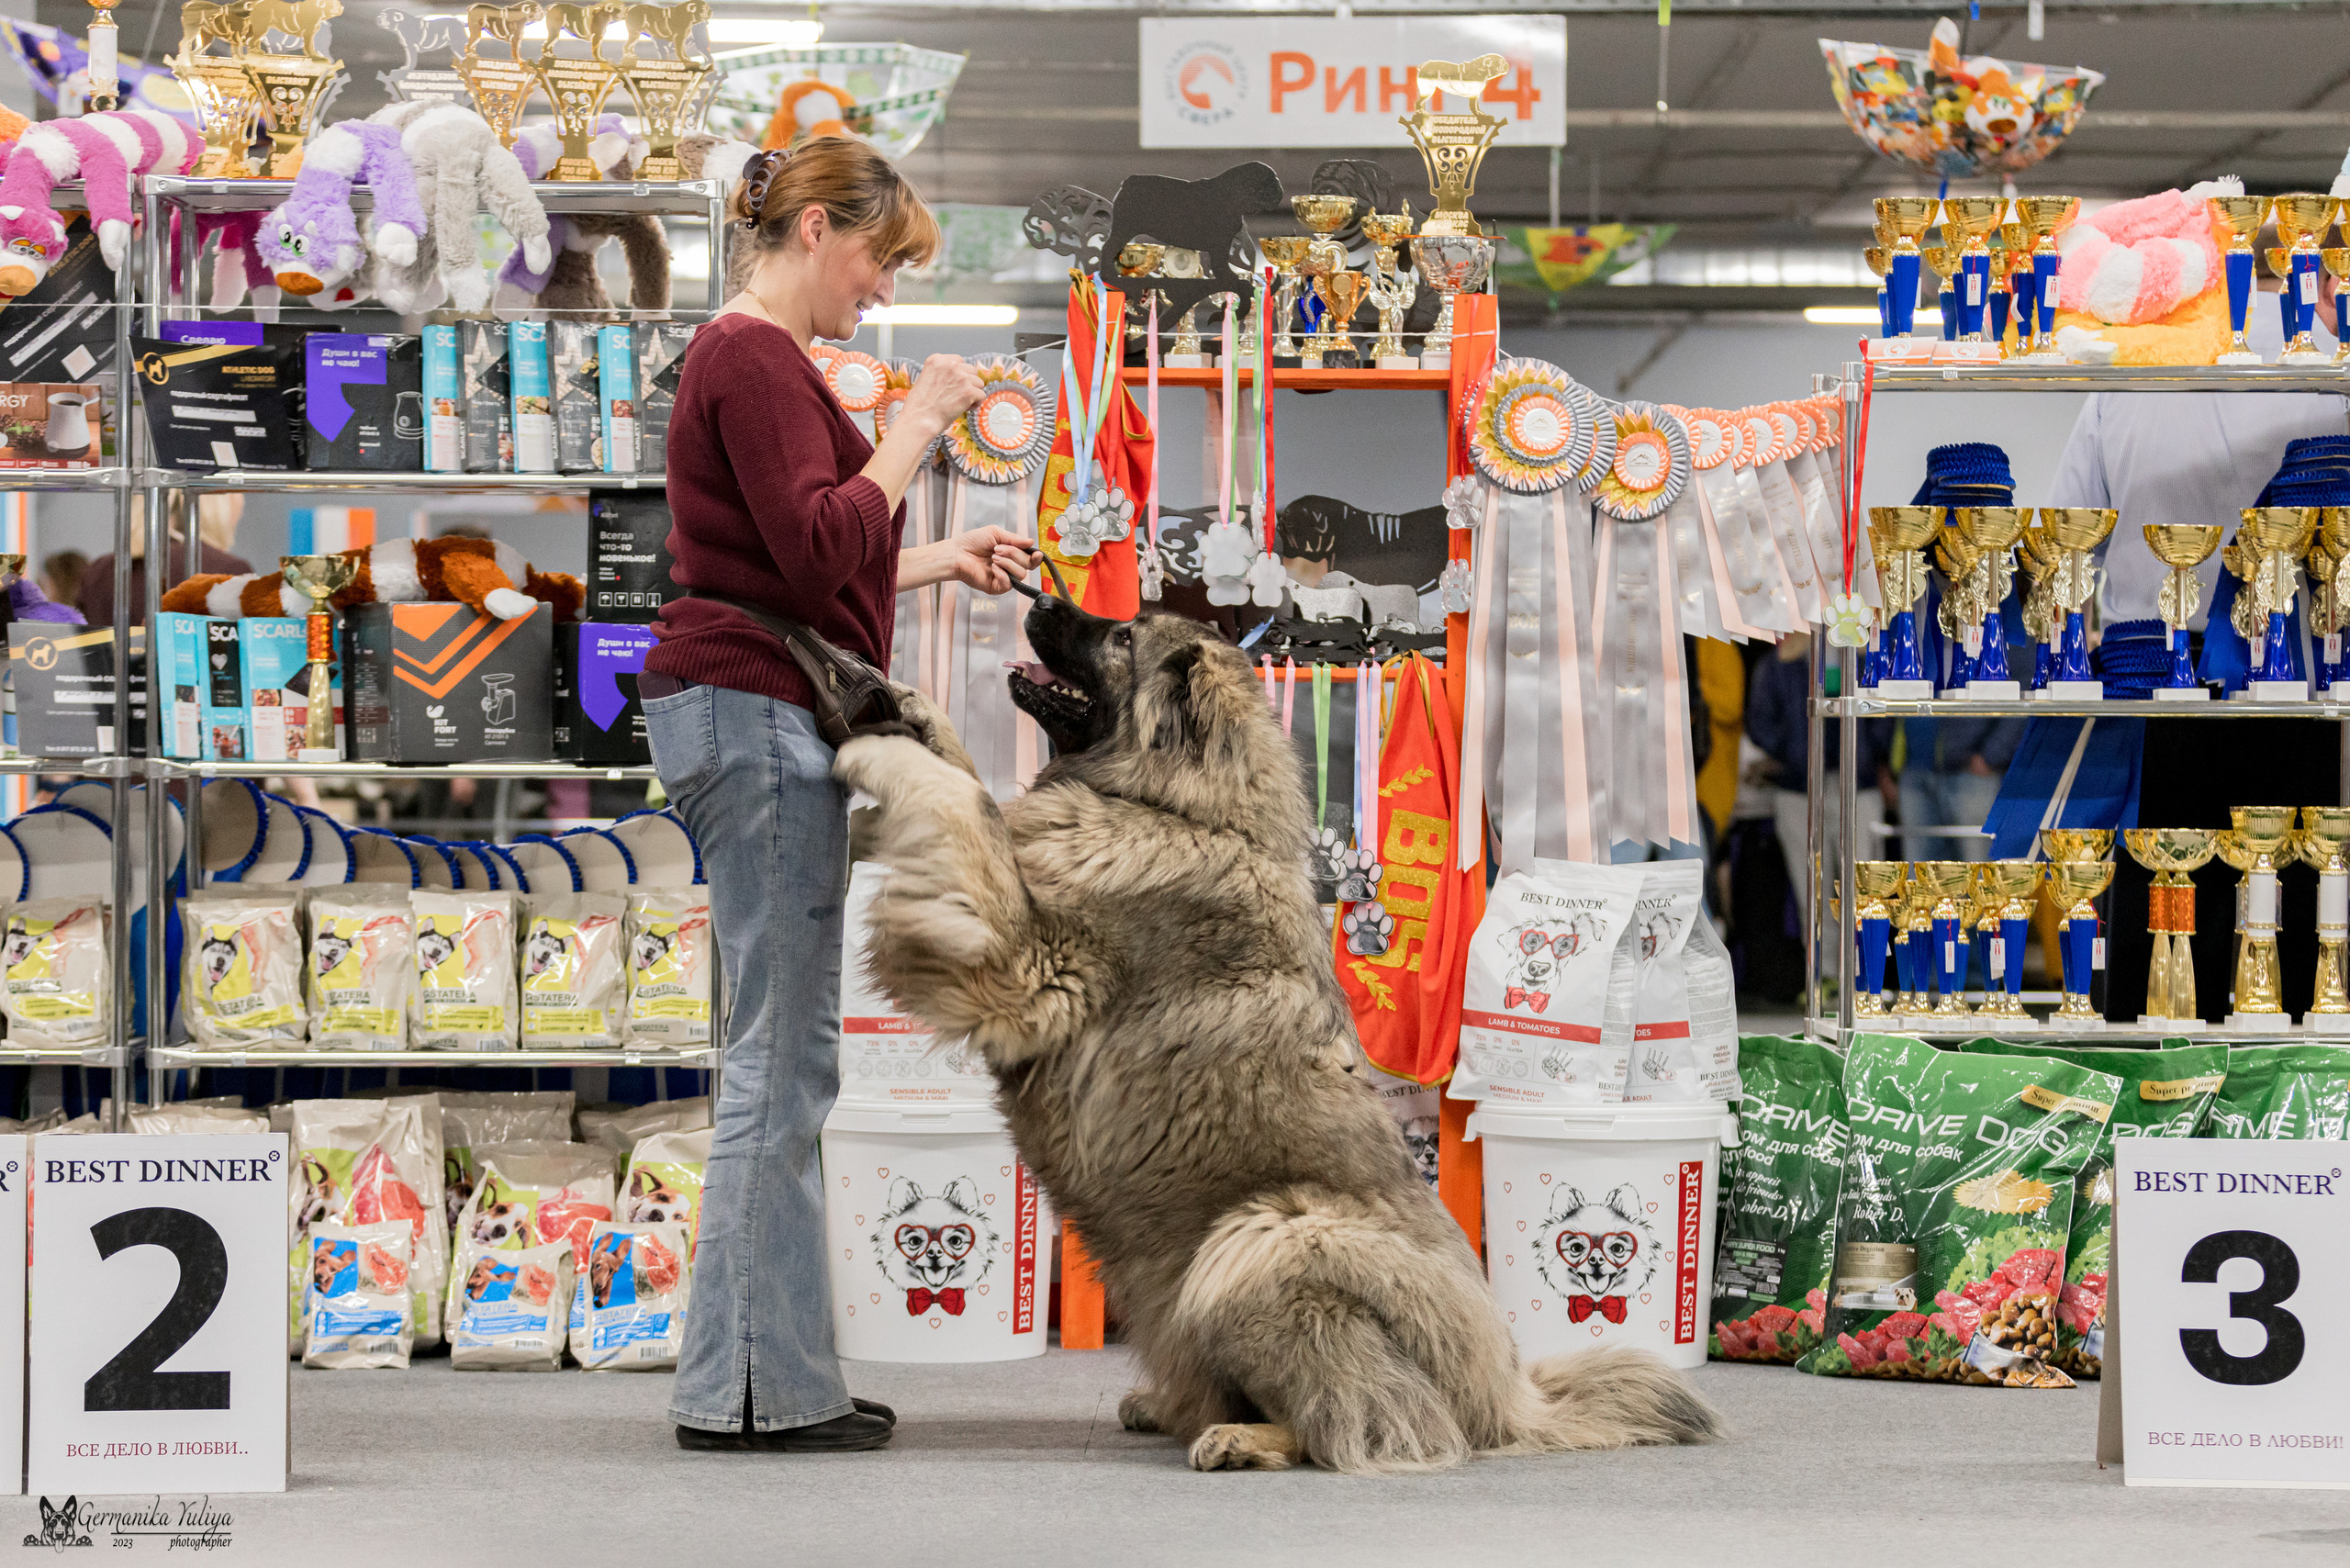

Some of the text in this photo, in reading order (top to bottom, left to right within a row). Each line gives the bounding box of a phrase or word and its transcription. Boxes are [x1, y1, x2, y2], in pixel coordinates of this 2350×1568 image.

[1482, 46, 1541, 121] 4
[1420, 125, 1487, 135] МНОПОРОДНОЙ
[321, 348, 351, 358] Души
[257, 365, 275, 374] DOG
[336, 359, 360, 367] чаю!
[599, 531, 634, 541] Всегда
[599, 543, 632, 552] что-то
[599, 554, 656, 563] новенькое!
[253, 623, 306, 639] SCARL
[597, 638, 624, 648] Души
[611, 649, 633, 657] чаю!
[1365, 808, 1450, 972] BOS
[1520, 891, 1604, 911] BEST DINNER
[878, 1022, 902, 1030] LAMB
[1488, 1017, 1561, 1035] LAMB & TOMATOES
[1700, 1071, 1718, 1081] BEST
[1489, 1084, 1545, 1098] SENSIBLE ADULT
[2031, 1089, 2055, 1106] Super
[2149, 1083, 2177, 1095] Super
[1741, 1093, 1851, 1148] DRIVE
[1847, 1097, 2069, 1157] DRIVE DOG
[1765, 1139, 1800, 1155] для
[1874, 1138, 1912, 1157] для
[1915, 1144, 1964, 1163] собак
[1743, 1146, 1775, 1167] food
[45, 1159, 272, 1183] BEST DINNER
[1746, 1170, 1781, 1187] appetit
[2134, 1170, 2335, 1195] BEST DINNER
[1771, 1205, 1788, 1222] D.
[1853, 1204, 1904, 1223] Rober D.
[1681, 1169, 1699, 1340] BEST DINNER
[1756, 1244, 1776, 1254] FOOD
[1019, 1266, 1032, 1330] BEST
[84, 1206, 230, 1412] 2
[2178, 1229, 2306, 1387] 3
[2148, 1431, 2344, 1450] ВСЕ ДЕЛО В ЛЮБВИ!
[66, 1441, 249, 1459] ВСЕ ДЕЛО В ЛЮБВИ..
